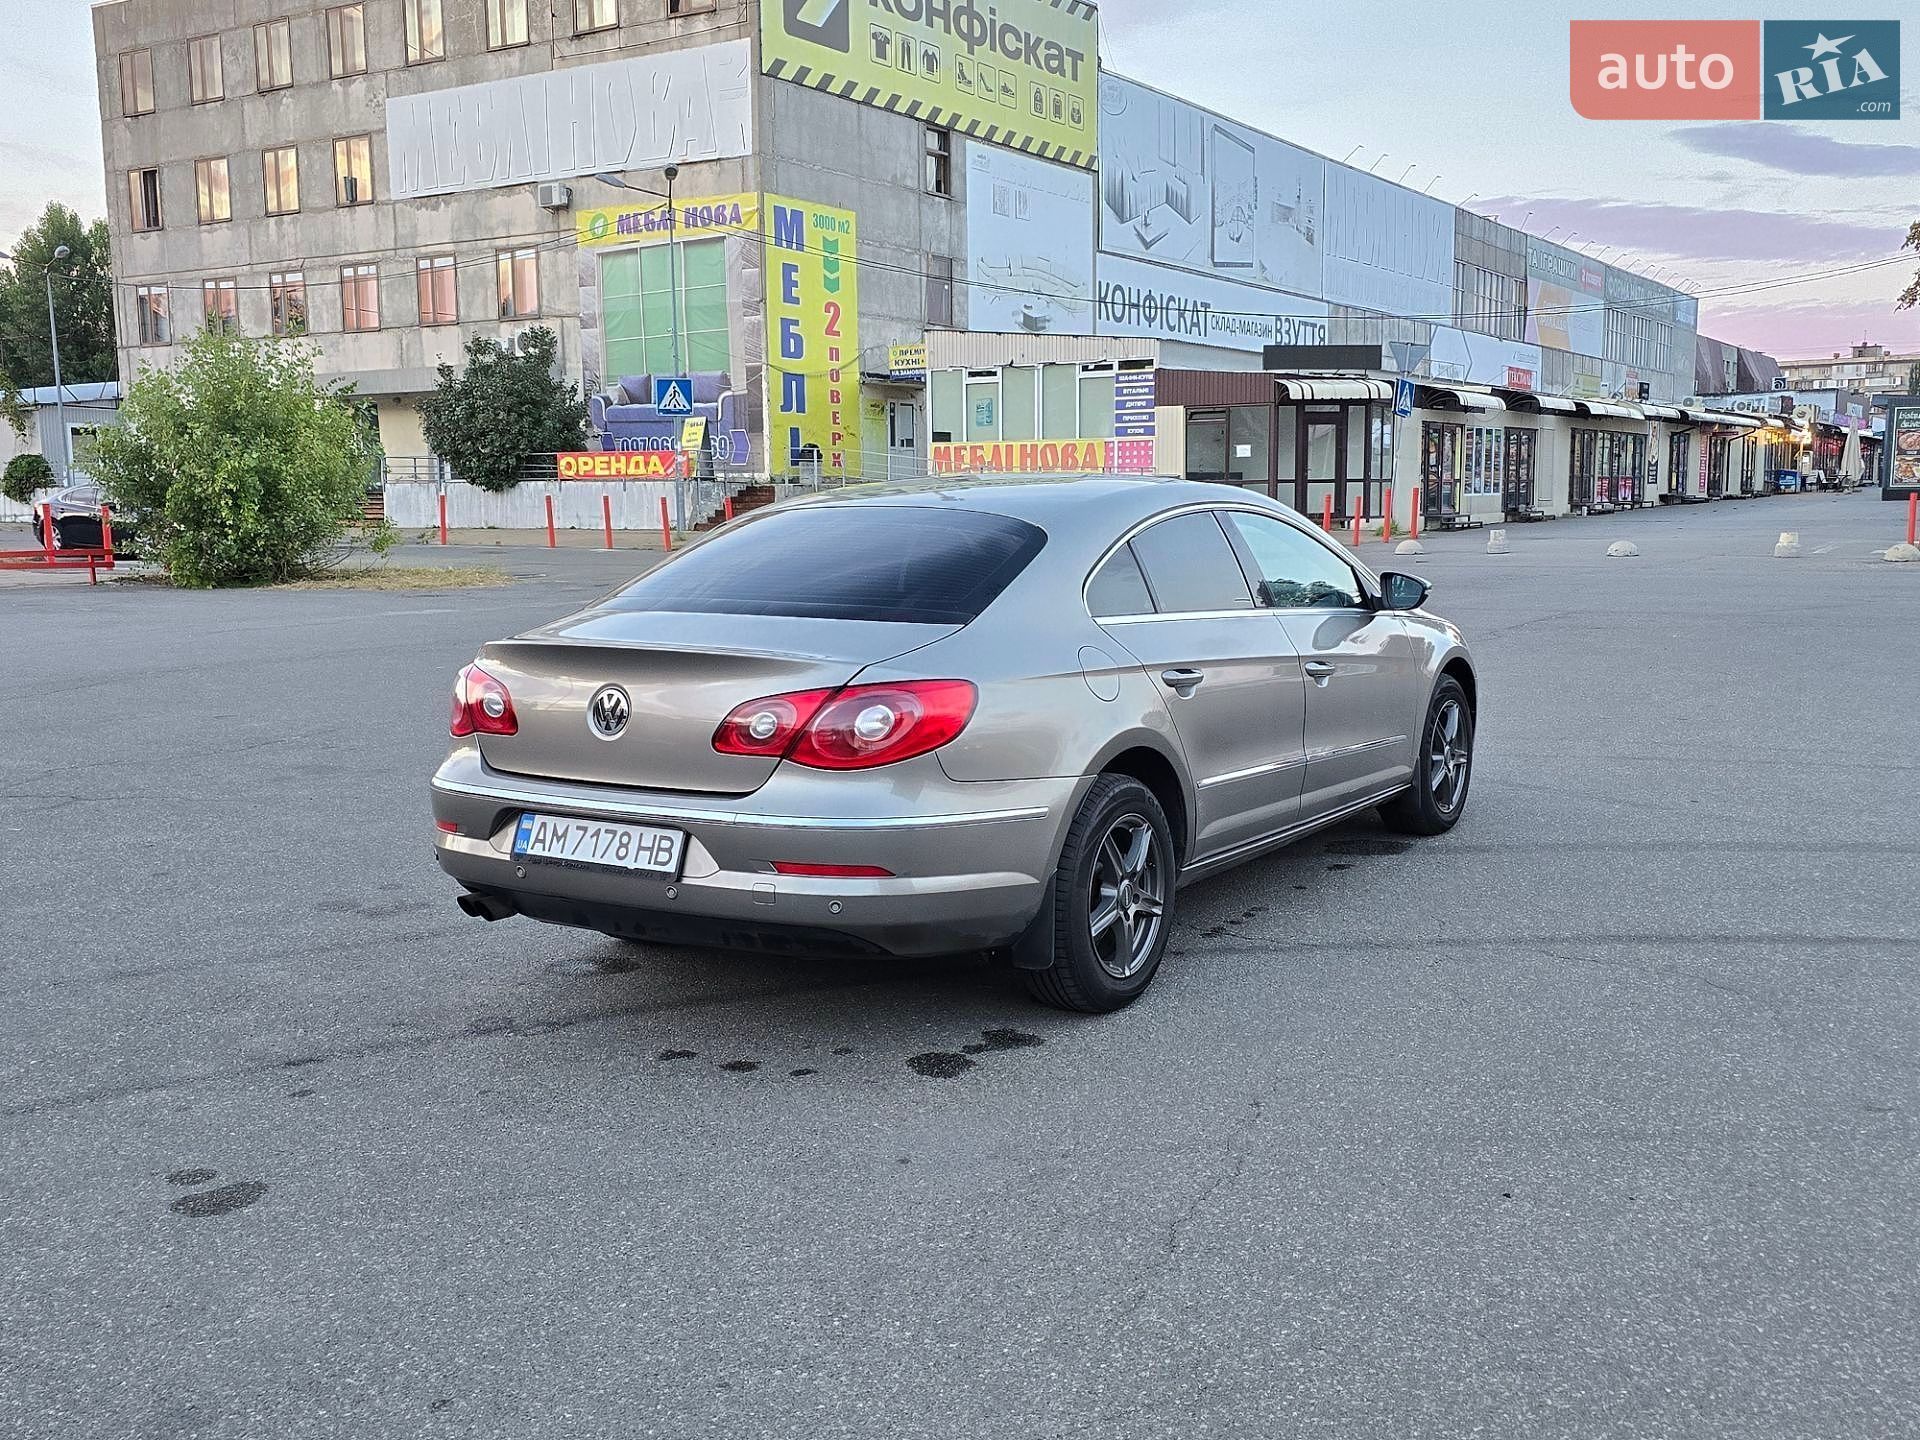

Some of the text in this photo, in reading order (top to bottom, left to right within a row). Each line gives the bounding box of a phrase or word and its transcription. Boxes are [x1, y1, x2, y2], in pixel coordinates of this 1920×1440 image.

[867, 0, 1085, 82] онфіскат
[617, 202, 743, 235] МЕБЛІ НОВА
[812, 213, 836, 231] 3000
[824, 301, 841, 337] 2
[1097, 280, 1327, 345] КОНФІСКАТ СКЛАД-МАГАЗИН ВЗУТТЯ
[894, 358, 920, 367] КУХНІ
[559, 454, 666, 477] ОРЕНДА
[517, 837, 529, 850] UA
